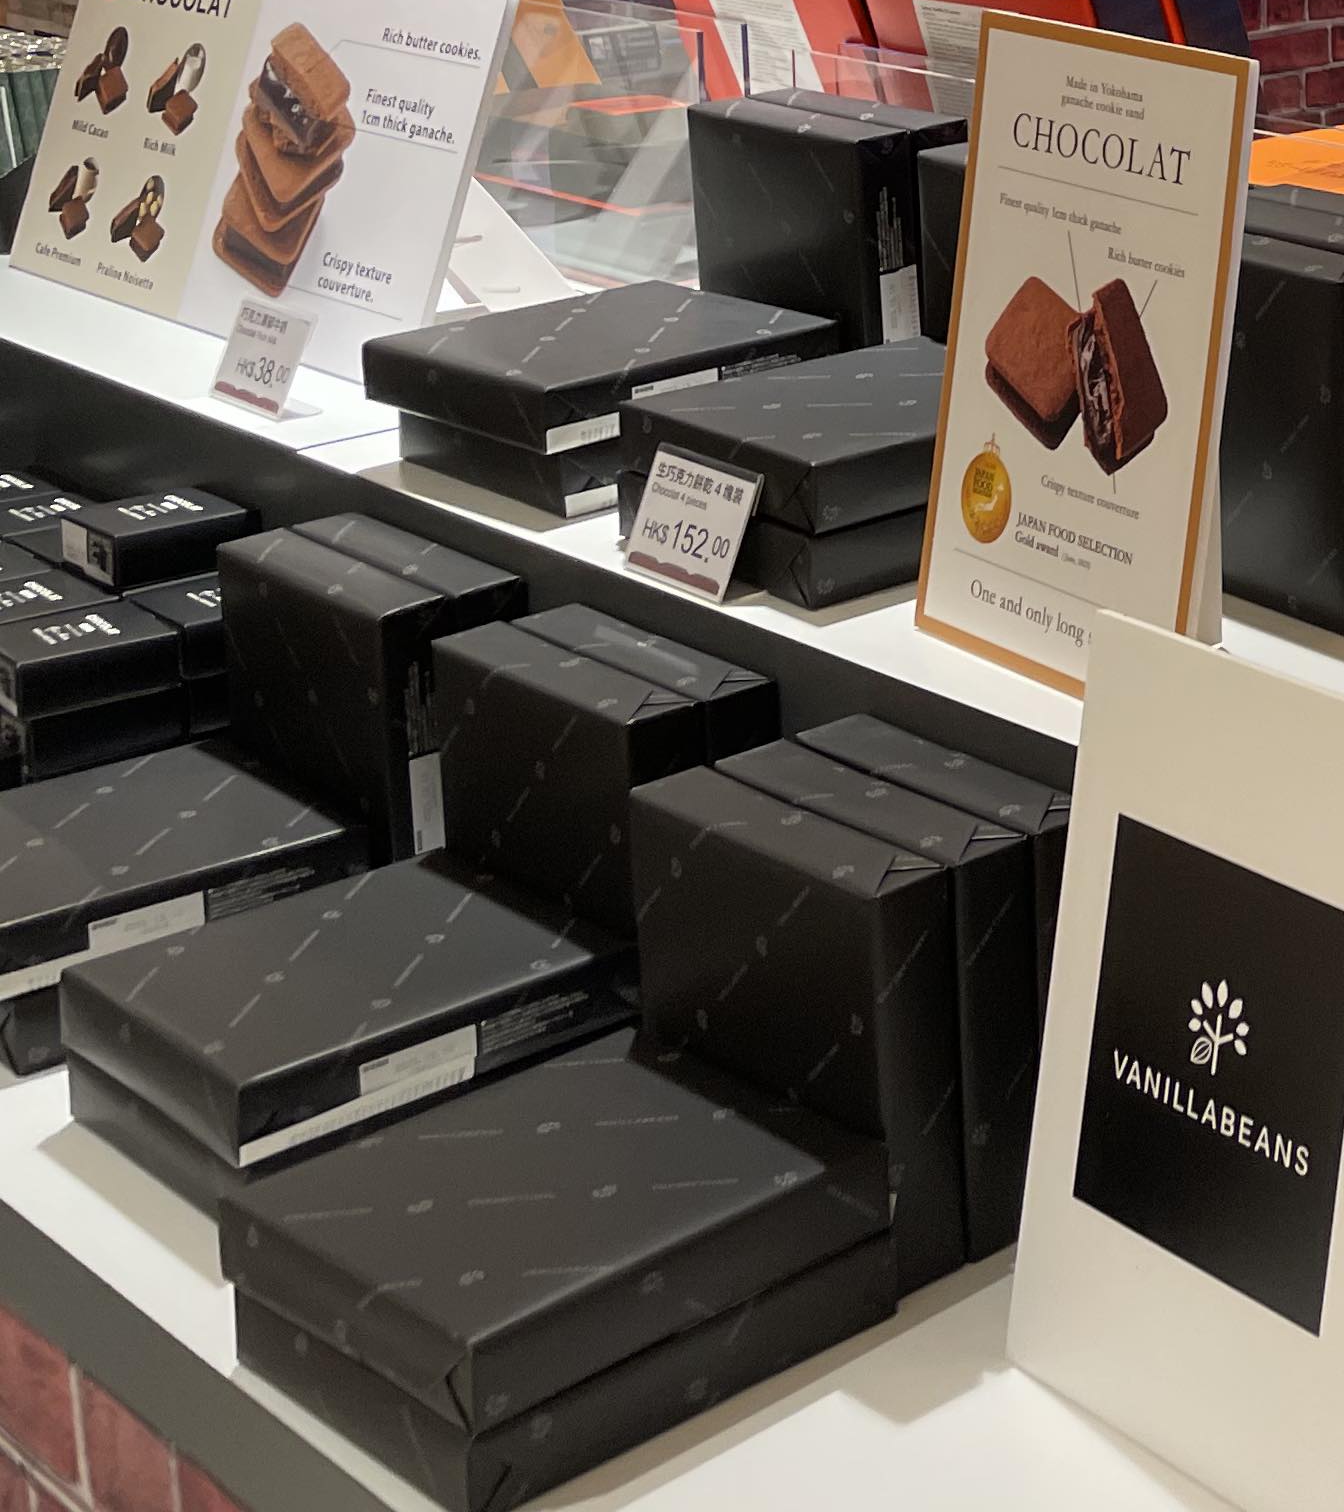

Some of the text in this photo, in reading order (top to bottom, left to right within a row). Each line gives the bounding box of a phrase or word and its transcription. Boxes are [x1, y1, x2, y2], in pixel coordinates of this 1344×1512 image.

[382, 27, 403, 45] Rich
[406, 31, 437, 51] butter
[1066, 75, 1143, 102] Made in Yokohama
[366, 89, 435, 120] Finest quality
[1061, 95, 1145, 120] ganache cookie sand
[72, 119, 88, 134] Mild
[361, 111, 381, 130] 1cm
[382, 114, 407, 137] thick
[143, 137, 176, 157] Rich Milk
[1013, 112, 1191, 185] CHOCOLAT
[1000, 192, 1022, 209] Finest
[1023, 202, 1050, 219] quality
[1068, 210, 1088, 227] thick
[1089, 218, 1122, 235] ganache
[97, 262, 123, 279] Praline
[323, 252, 392, 285] Crispy texture
[1108, 246, 1185, 278] Rich butter cookies
[1041, 474, 1065, 496] Crispy
[1096, 495, 1140, 520] couverture
[1015, 511, 1046, 534] JAPAN
[1047, 522, 1076, 544] FOOD
[1077, 532, 1133, 565] SELECTION
[1015, 530, 1034, 549] Gold
[970, 579, 1085, 648] One and only long
[1113, 1048, 1309, 1176] VANILLABEANS
